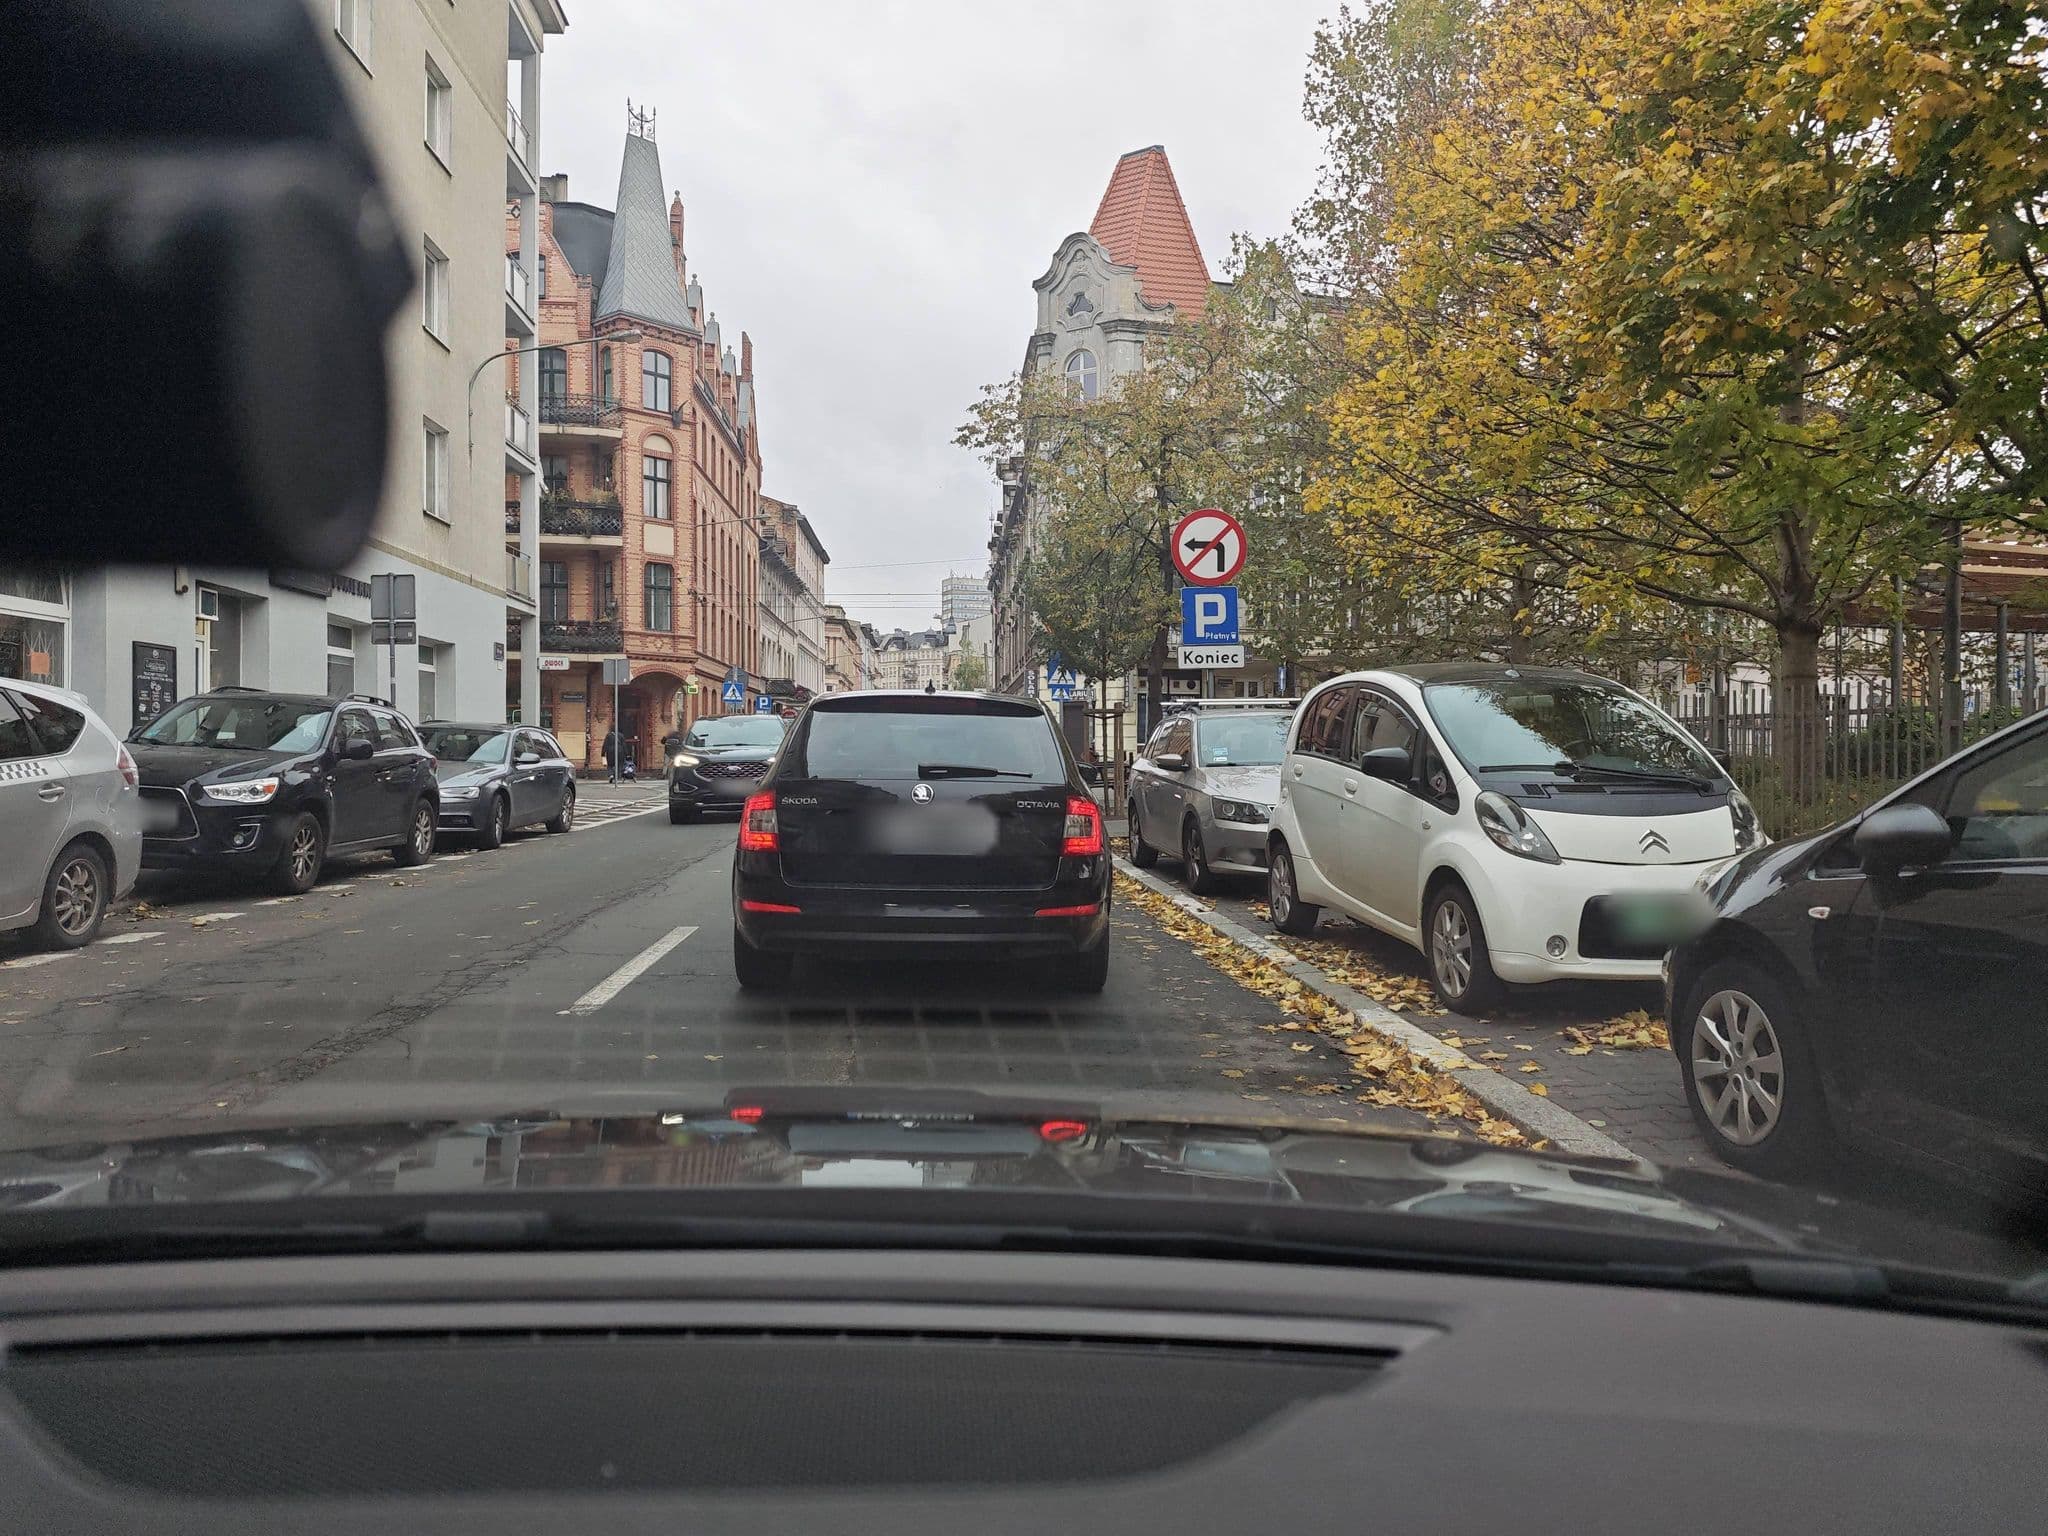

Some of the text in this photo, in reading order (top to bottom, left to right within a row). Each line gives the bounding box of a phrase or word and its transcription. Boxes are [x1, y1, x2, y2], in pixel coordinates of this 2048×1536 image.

[1194, 593, 1227, 638] P
[1183, 651, 1239, 665] Koniec
[1016, 800, 1061, 809] OCTAVIA
